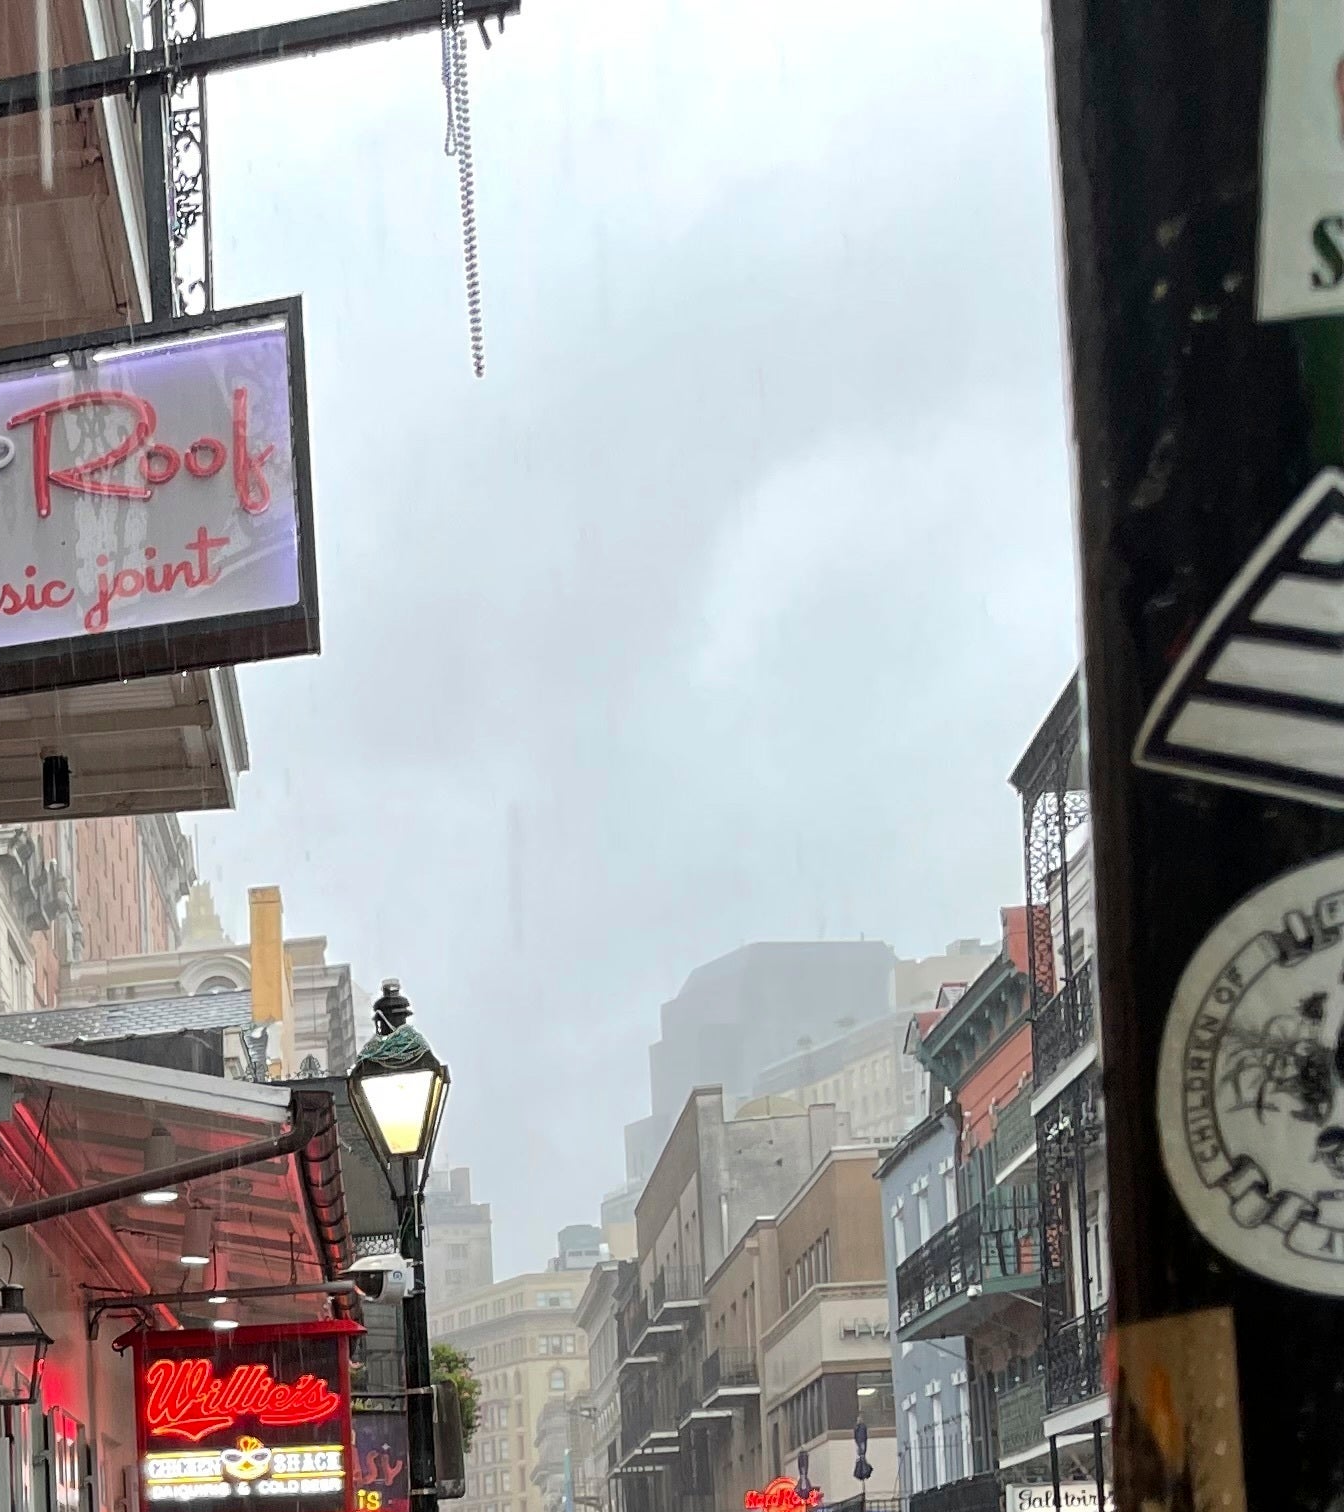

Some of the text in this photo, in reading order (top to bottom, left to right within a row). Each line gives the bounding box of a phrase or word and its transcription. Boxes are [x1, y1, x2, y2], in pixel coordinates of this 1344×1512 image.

[6, 386, 276, 518] Roof
[84, 525, 231, 635] joint
[839, 1316, 890, 1339] HY
[146, 1358, 340, 1429] Willie's
[272, 1452, 342, 1474] SHACK
[257, 1479, 299, 1496] COLD
[778, 1488, 823, 1508] Rok
[1018, 1490, 1106, 1511] Galtoir
